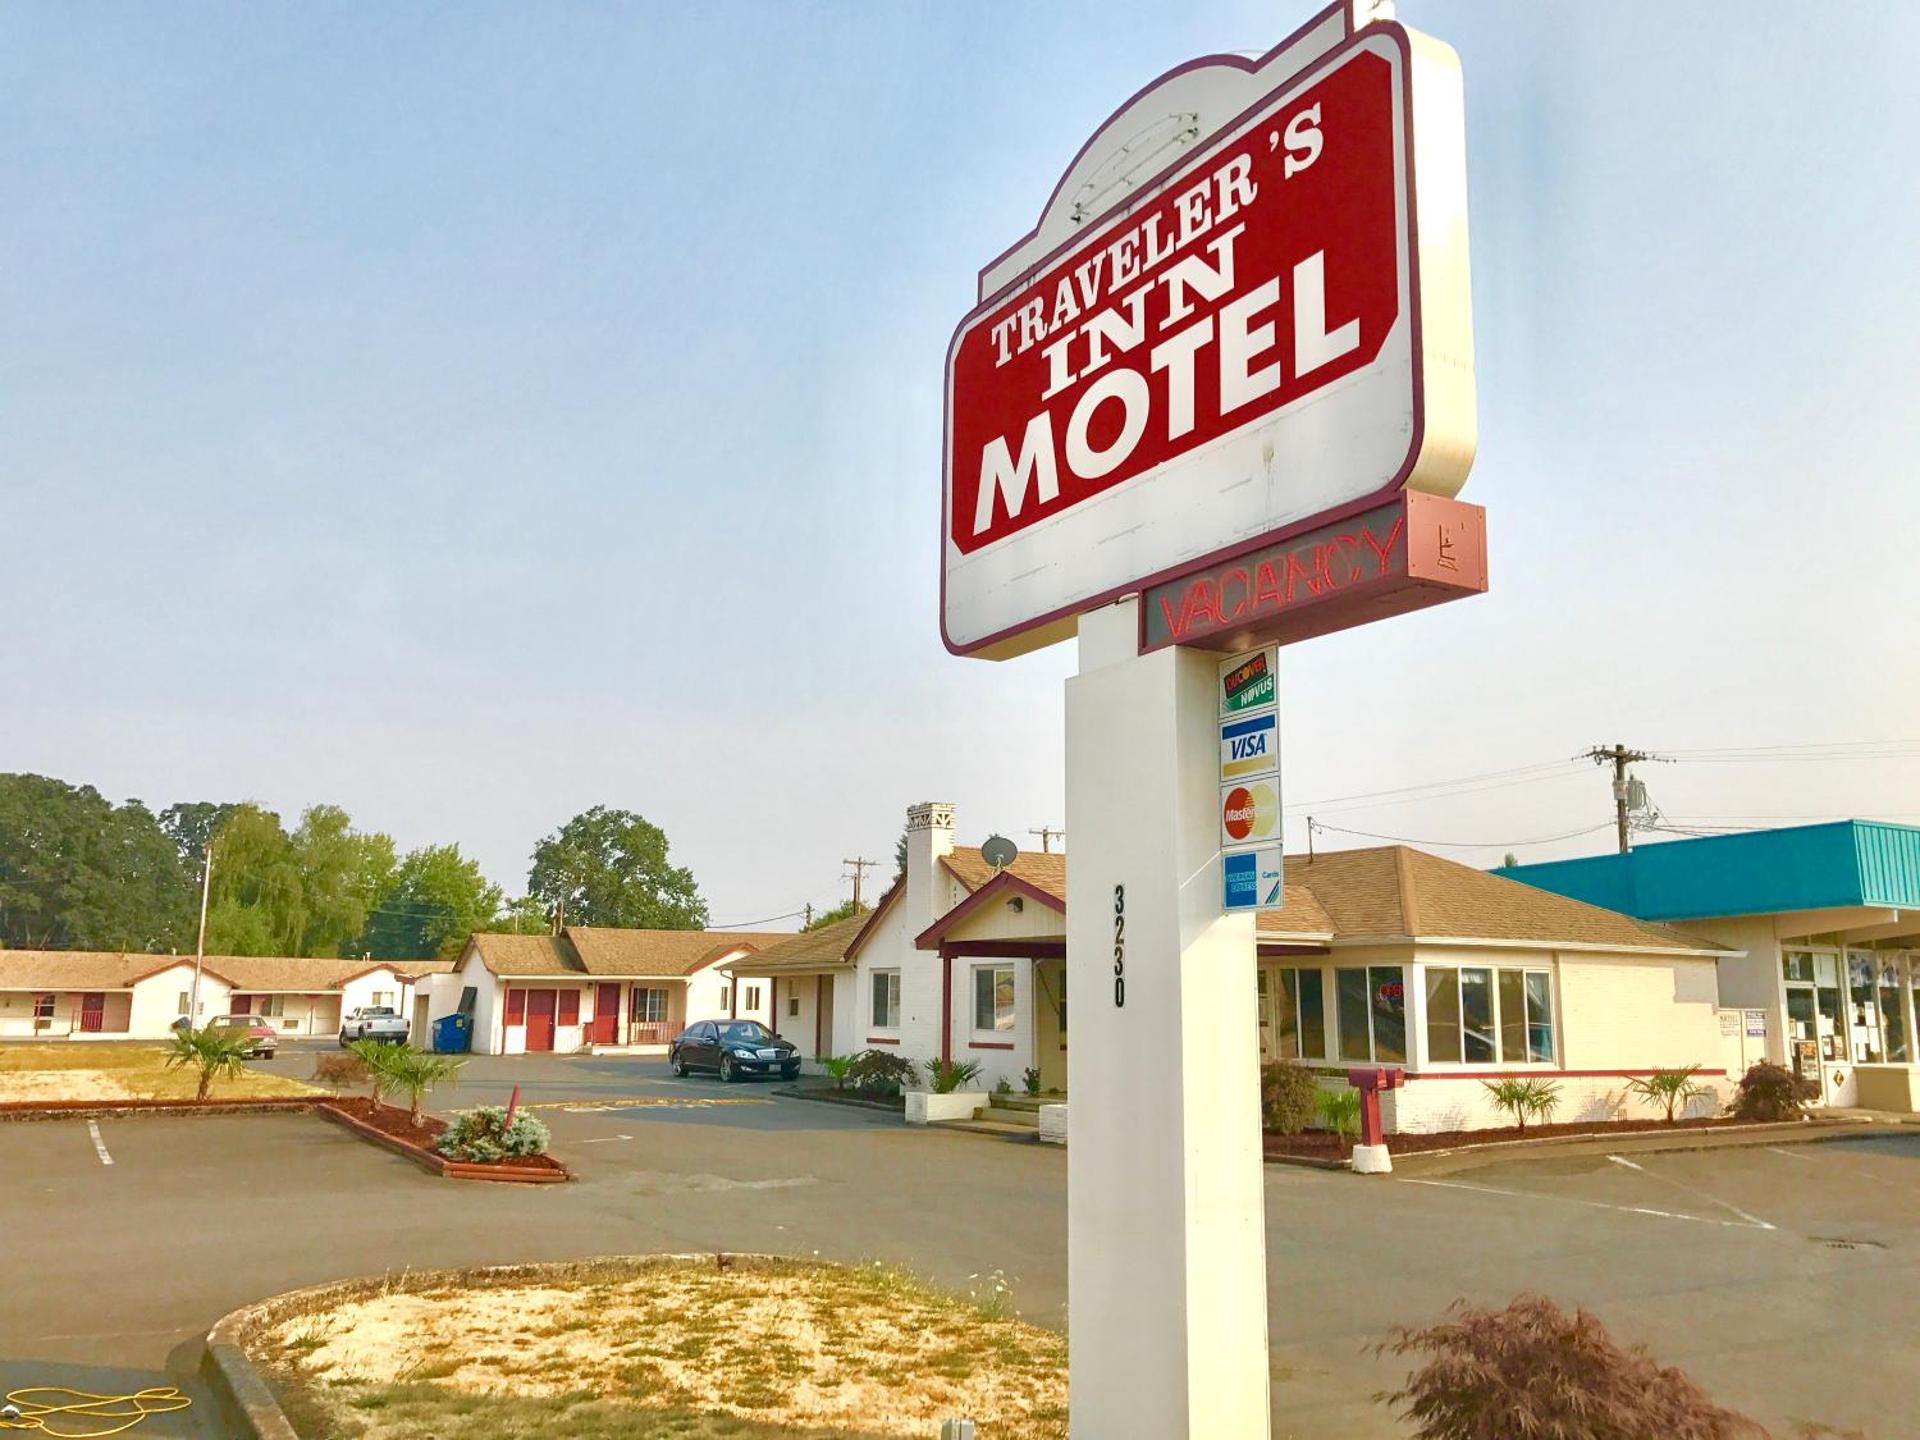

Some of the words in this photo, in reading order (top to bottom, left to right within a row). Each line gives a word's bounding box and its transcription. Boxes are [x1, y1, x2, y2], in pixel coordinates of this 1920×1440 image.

[1041, 223, 1246, 402] INN
[971, 249, 1360, 536] MOTEL
[1160, 518, 1403, 639] VACANCY
[1231, 733, 1266, 760] VISA
[1240, 676, 1273, 707] NOVUS
[1114, 884, 1125, 1008] 3230
